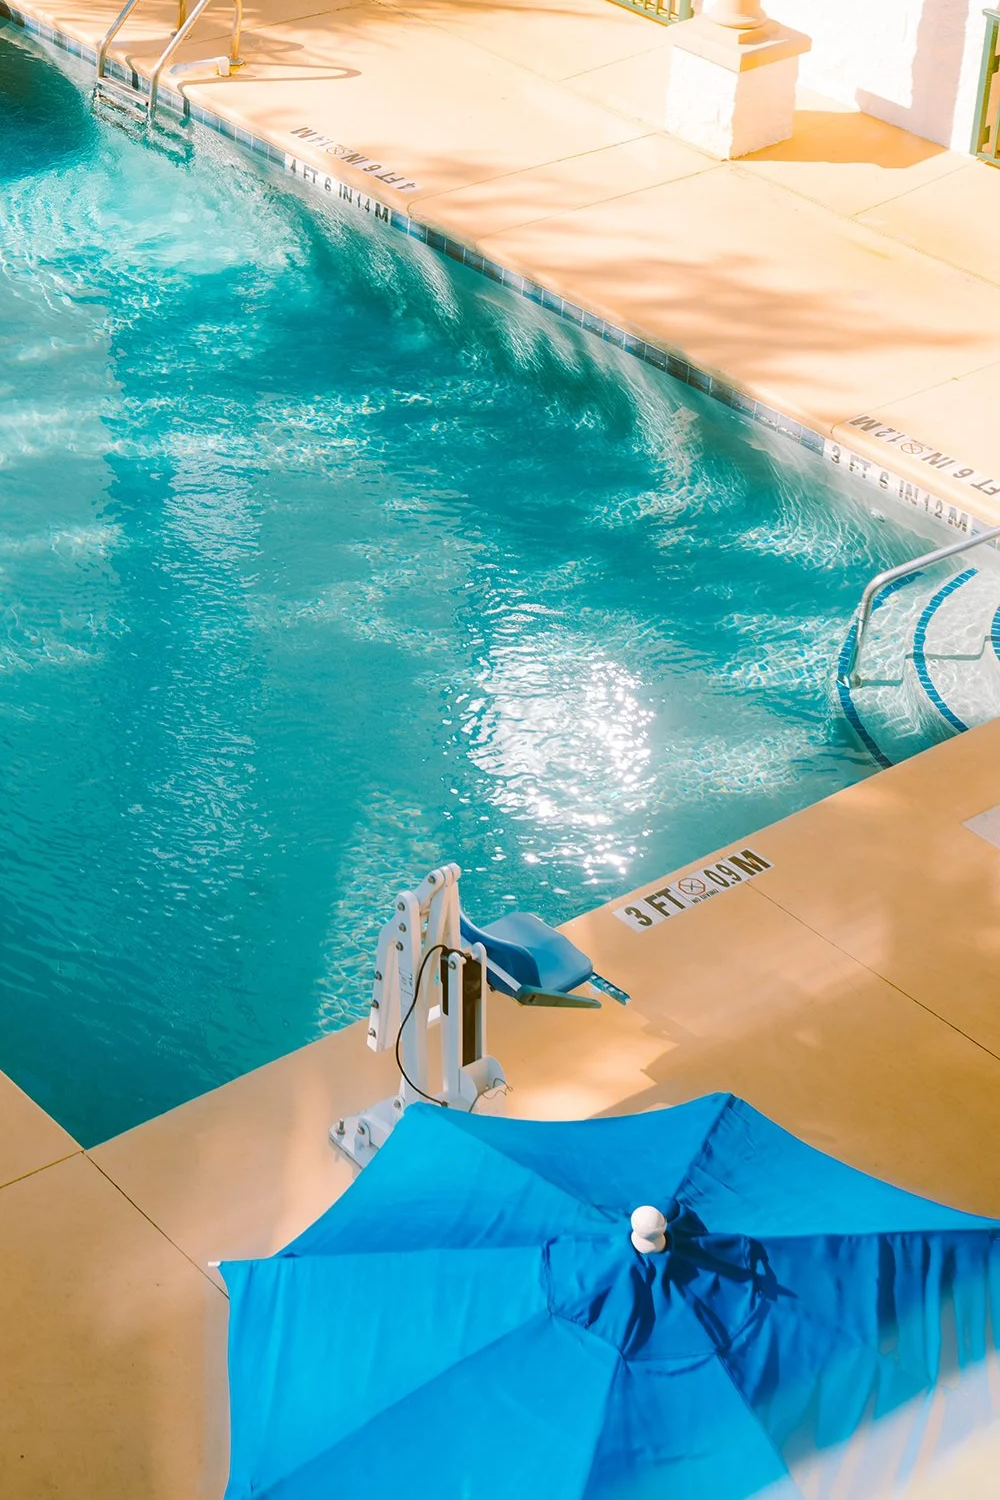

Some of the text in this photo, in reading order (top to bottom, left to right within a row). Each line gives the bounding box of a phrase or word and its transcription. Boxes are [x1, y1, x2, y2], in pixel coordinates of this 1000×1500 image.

[290, 127, 317, 139] M
[342, 153, 368, 165] IN
[363, 164, 382, 172] 6
[376, 172, 404, 184] FT
[291, 159, 296, 173] 4
[304, 165, 318, 184] FT
[325, 177, 331, 192] 6
[339, 184, 352, 203] IN
[375, 203, 388, 223] M
[849, 416, 882, 431] M
[831, 445, 840, 464] 3
[922, 452, 955, 469] IN
[953, 468, 974, 478] 6
[624, 850, 771, 926] 3 FT 0.9 M
